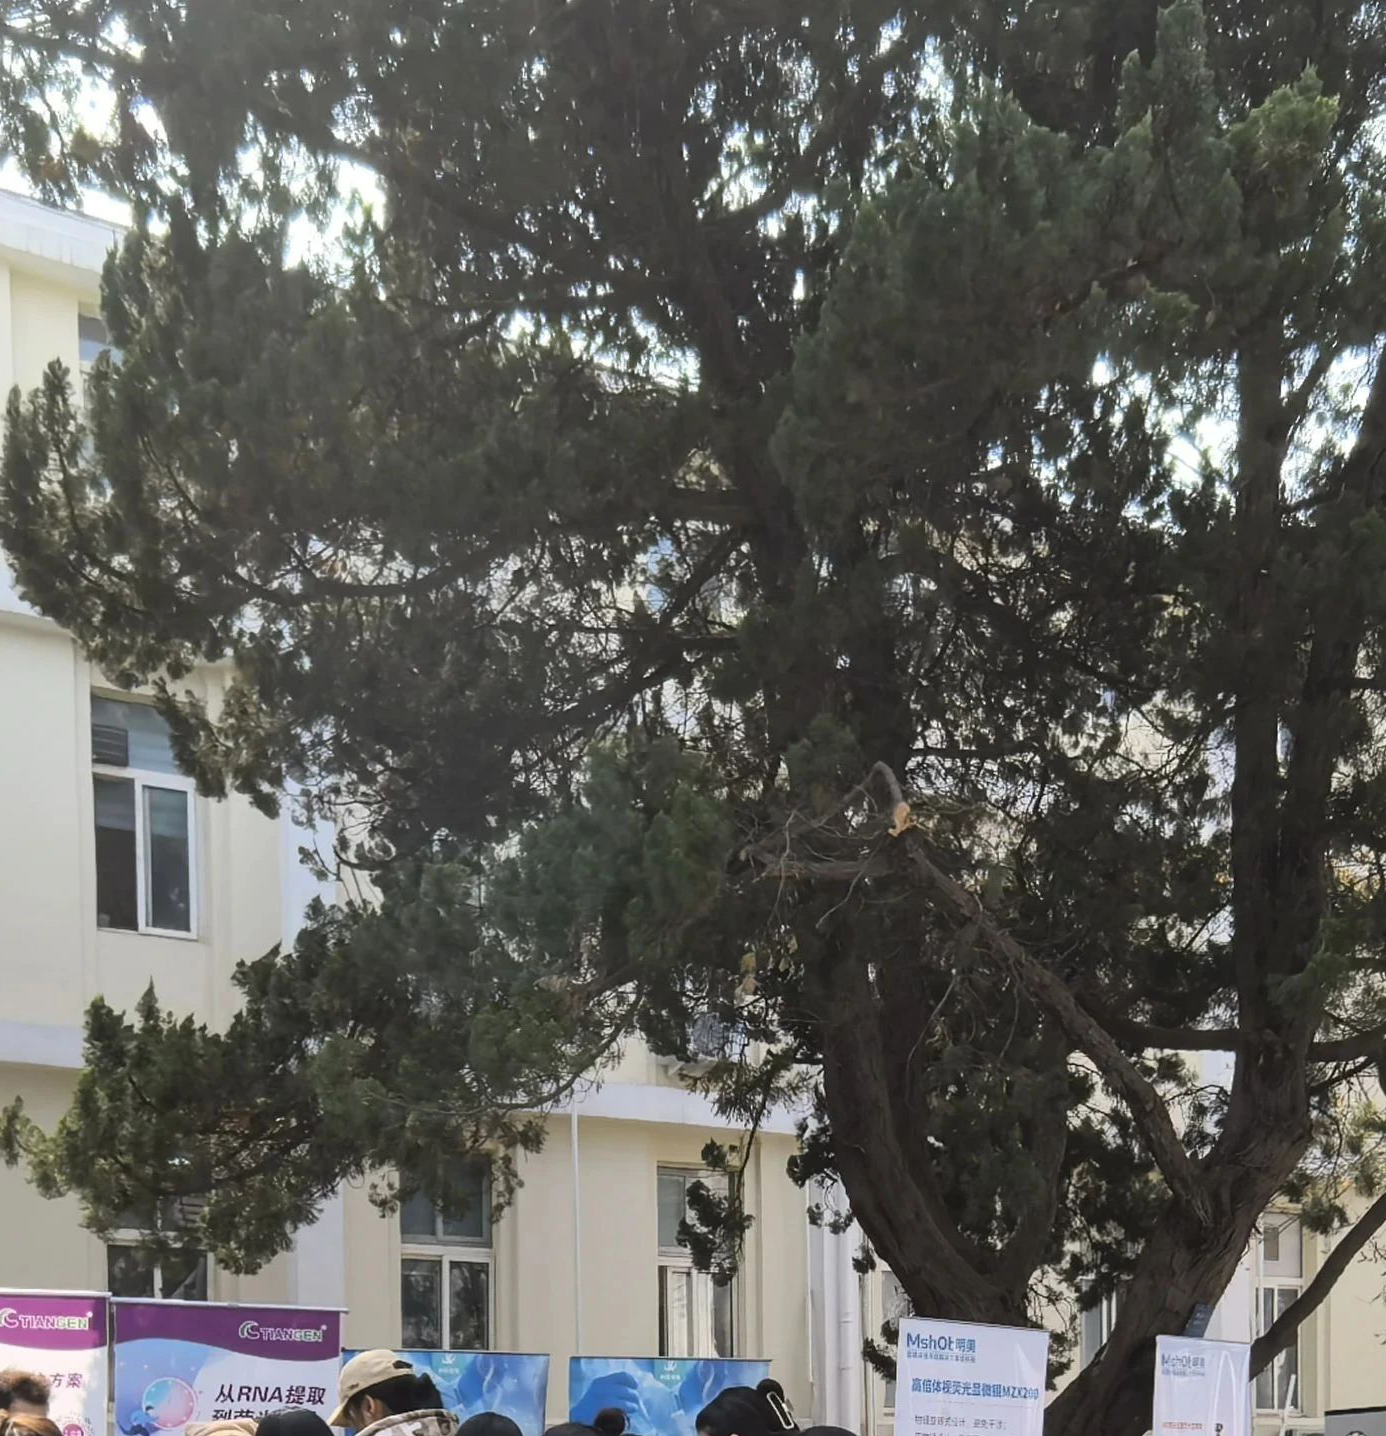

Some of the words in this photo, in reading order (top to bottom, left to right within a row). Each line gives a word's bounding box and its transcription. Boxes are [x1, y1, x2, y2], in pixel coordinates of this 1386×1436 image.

[18, 1315, 89, 1331] TIANGEN
[259, 1327, 323, 1342] TIANGEN
[215, 1384, 326, 1405] 从RNA提取
